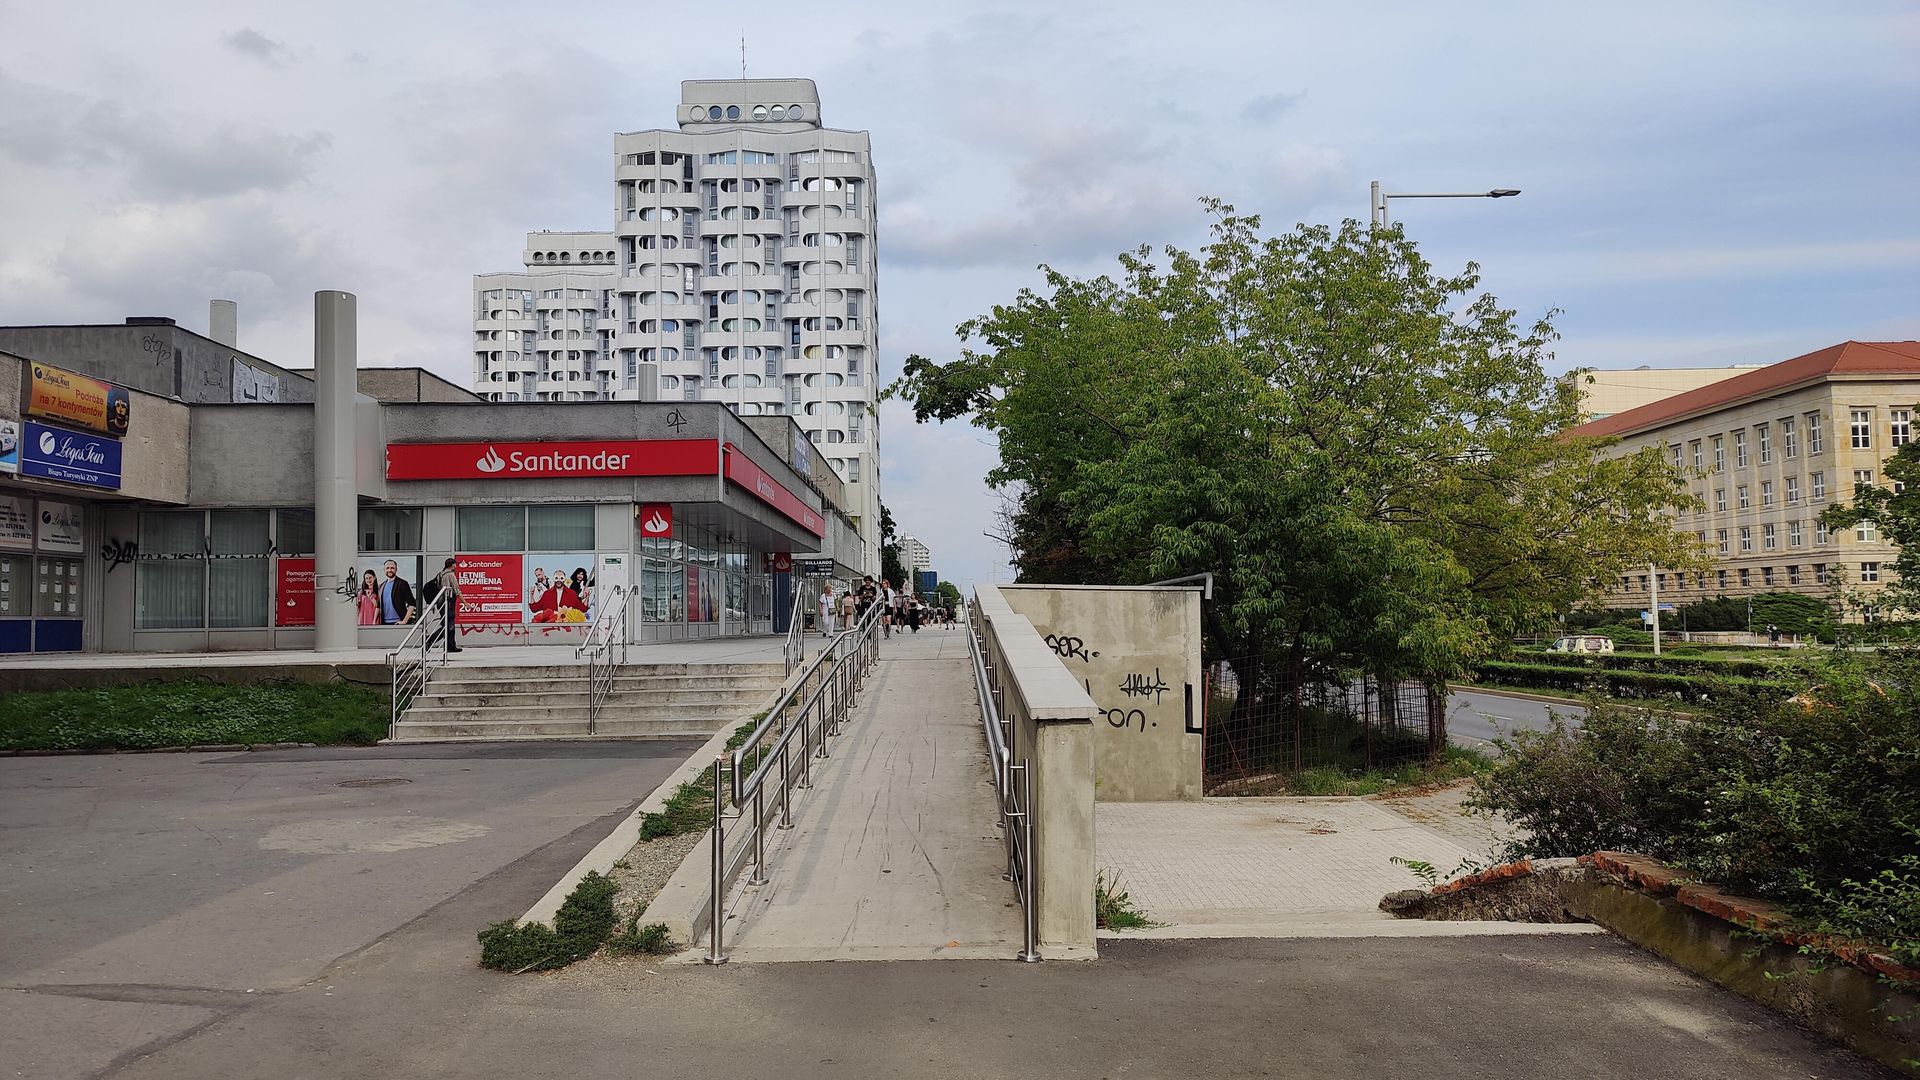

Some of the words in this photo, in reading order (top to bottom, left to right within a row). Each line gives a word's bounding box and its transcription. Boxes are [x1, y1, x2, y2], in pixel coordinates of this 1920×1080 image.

[39, 394, 49, 404] na
[51, 397, 57, 406] 7
[57, 398, 104, 418] kontynentów
[75, 388, 104, 405] Podróże
[509, 450, 631, 472] Santander
